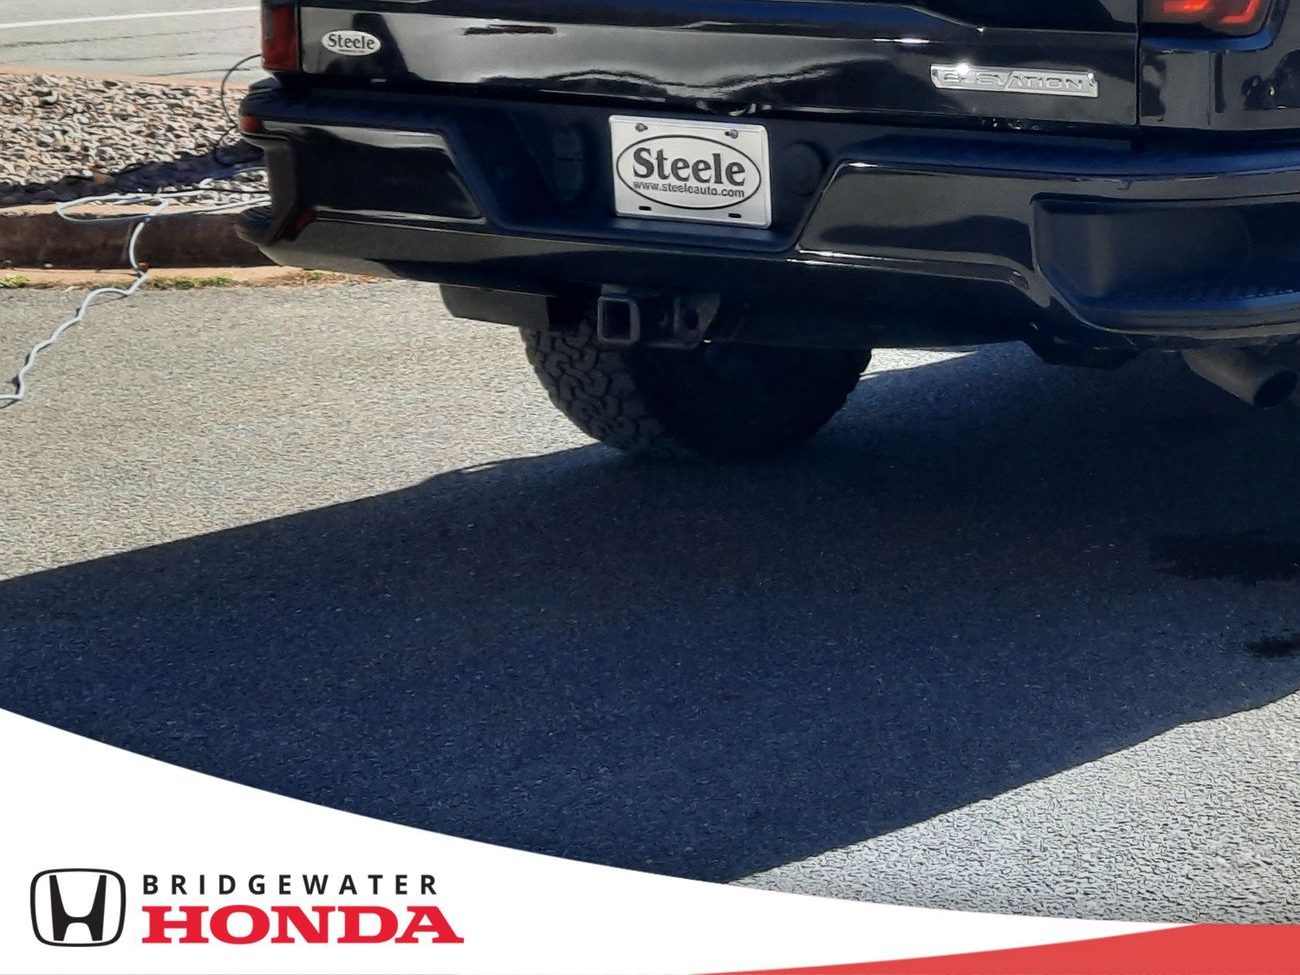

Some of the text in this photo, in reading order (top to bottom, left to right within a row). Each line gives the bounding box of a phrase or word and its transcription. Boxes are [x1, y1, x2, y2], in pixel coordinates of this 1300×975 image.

[328, 33, 375, 50] Steele
[632, 147, 746, 186] Steele
[633, 181, 745, 198] www.steeleauto.com
